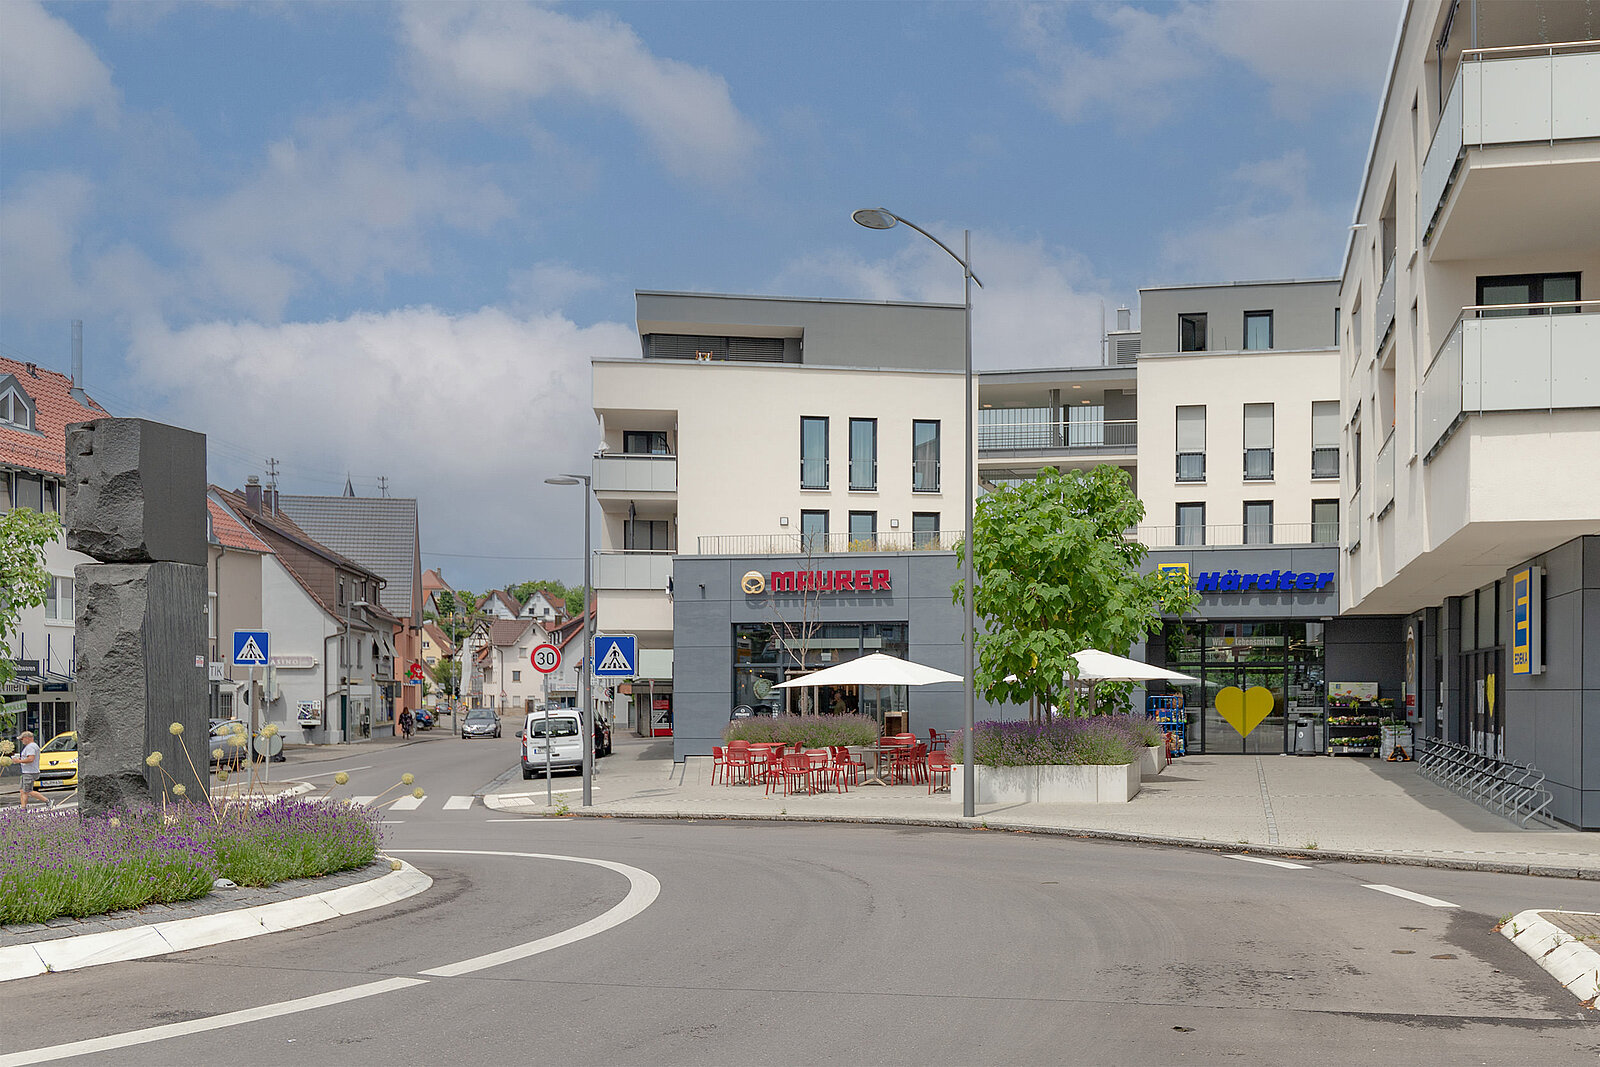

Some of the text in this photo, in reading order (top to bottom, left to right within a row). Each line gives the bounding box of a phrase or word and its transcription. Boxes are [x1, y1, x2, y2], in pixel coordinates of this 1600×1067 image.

[770, 569, 891, 592] MAURER
[1196, 569, 1335, 591] Härdter
[1212, 637, 1278, 647] Wir Lebensmittel.
[270, 658, 299, 666] ASINO
[536, 651, 555, 666] 30
[1515, 652, 1528, 665] EDEKA
[210, 665, 224, 678] TIK
